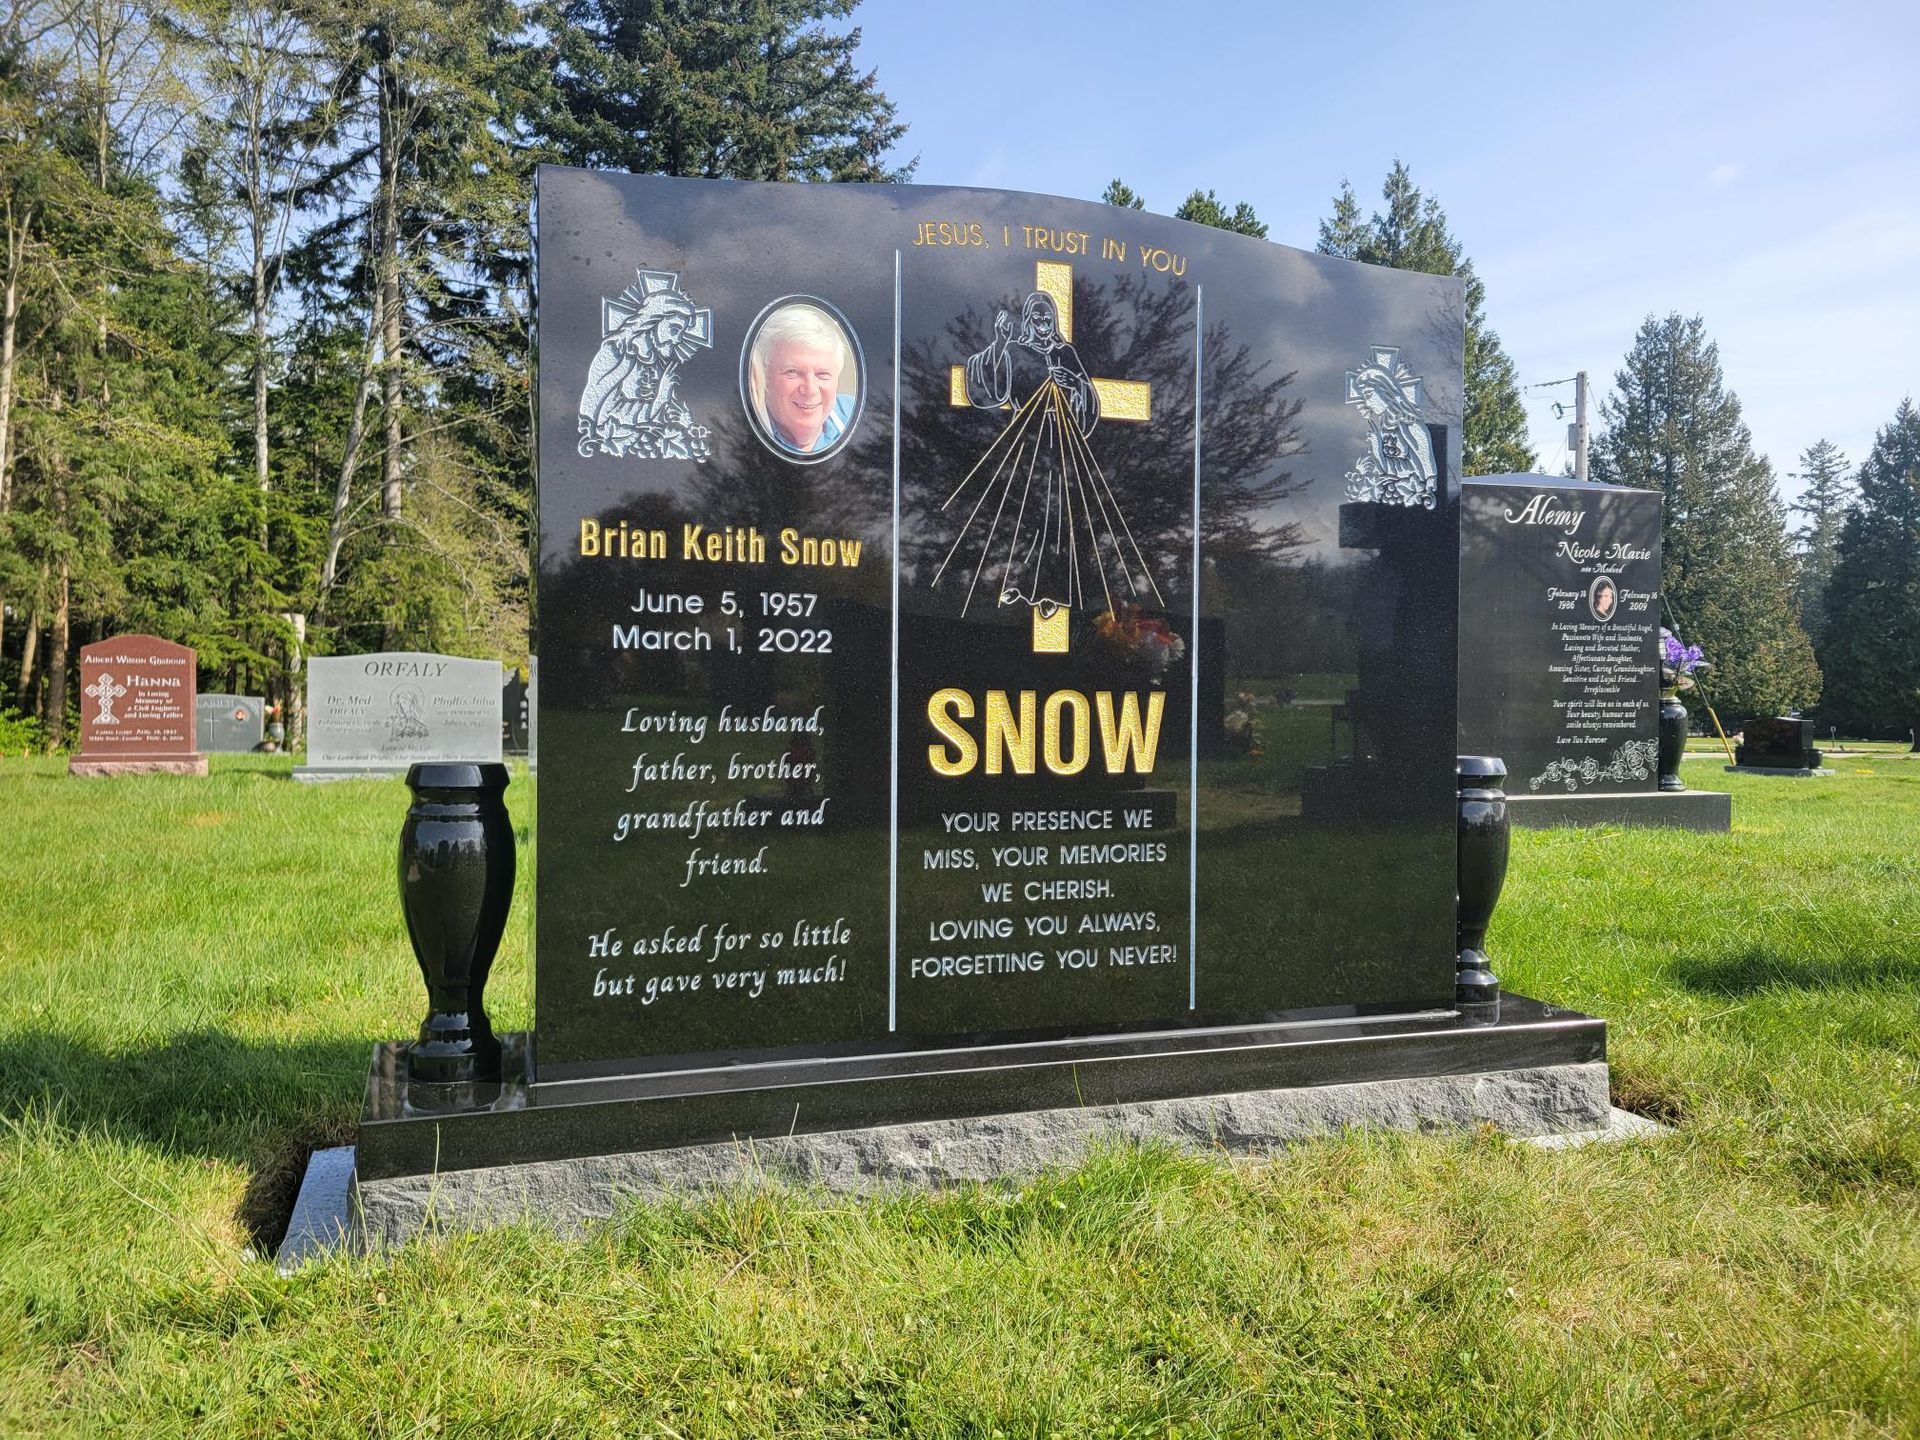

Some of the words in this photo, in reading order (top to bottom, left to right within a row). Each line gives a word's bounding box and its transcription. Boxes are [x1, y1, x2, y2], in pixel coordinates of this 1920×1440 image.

[912, 222, 990, 248] JESUS,
[1003, 224, 1009, 247] I
[1023, 225, 1090, 255] TRUST
[1102, 238, 1127, 262] IN
[1139, 244, 1188, 276] YOU
[1504, 494, 1586, 535] Alemy
[580, 517, 667, 559] Brian
[683, 522, 766, 563] Keith
[780, 527, 863, 567] Snow
[1556, 541, 1600, 564] Nicole
[1605, 543, 1651, 561] Marie
[631, 588, 704, 614] June
[720, 591, 744, 618] 5,
[760, 591, 818, 617] 1957
[1547, 587, 1579, 601] February
[1620, 589, 1650, 603] February
[1629, 602, 1648, 611] 2009
[613, 624, 712, 651] March
[726, 627, 742, 654] 1,
[758, 628, 833, 653] 2022
[1579, 623, 1600, 632] Memory
[1612, 623, 1637, 633] Beautiful
[364, 661, 448, 677] ORFALY
[621, 707, 708, 743] Loving
[718, 705, 825, 736] husband,
[927, 687, 1166, 776] SNOW
[625, 752, 717, 792] father,
[727, 752, 821, 783] brother,
[613, 800, 772, 841] grandfather
[781, 798, 830, 826] and
[941, 812, 1000, 833] YOUR
[1011, 809, 1113, 831] PRESENCE
[1123, 808, 1153, 828] WE
[679, 846, 769, 887] friend.
[923, 849, 980, 870] MISS,
[992, 846, 1049, 867] YOUR
[1060, 843, 1167, 865] MEMORIES
[981, 883, 1013, 903] WE
[1024, 879, 1115, 901] CHERISH.
[588, 927, 623, 957] He
[633, 924, 708, 956] asked
[706, 923, 751, 963] for
[759, 929, 784, 949] so
[793, 917, 851, 947] little
[929, 917, 1014, 941] LOVING
[1024, 915, 1068, 936] YOU
[1078, 911, 1161, 934] ALWAYS,
[910, 951, 1046, 978] FORGETTING
[1055, 949, 1099, 970] YOU
[1109, 944, 1177, 966] NEVER!
[593, 968, 636, 997] but
[641, 973, 702, 1005] gave
[712, 969, 767, 998] very
[777, 955, 847, 985] much!
